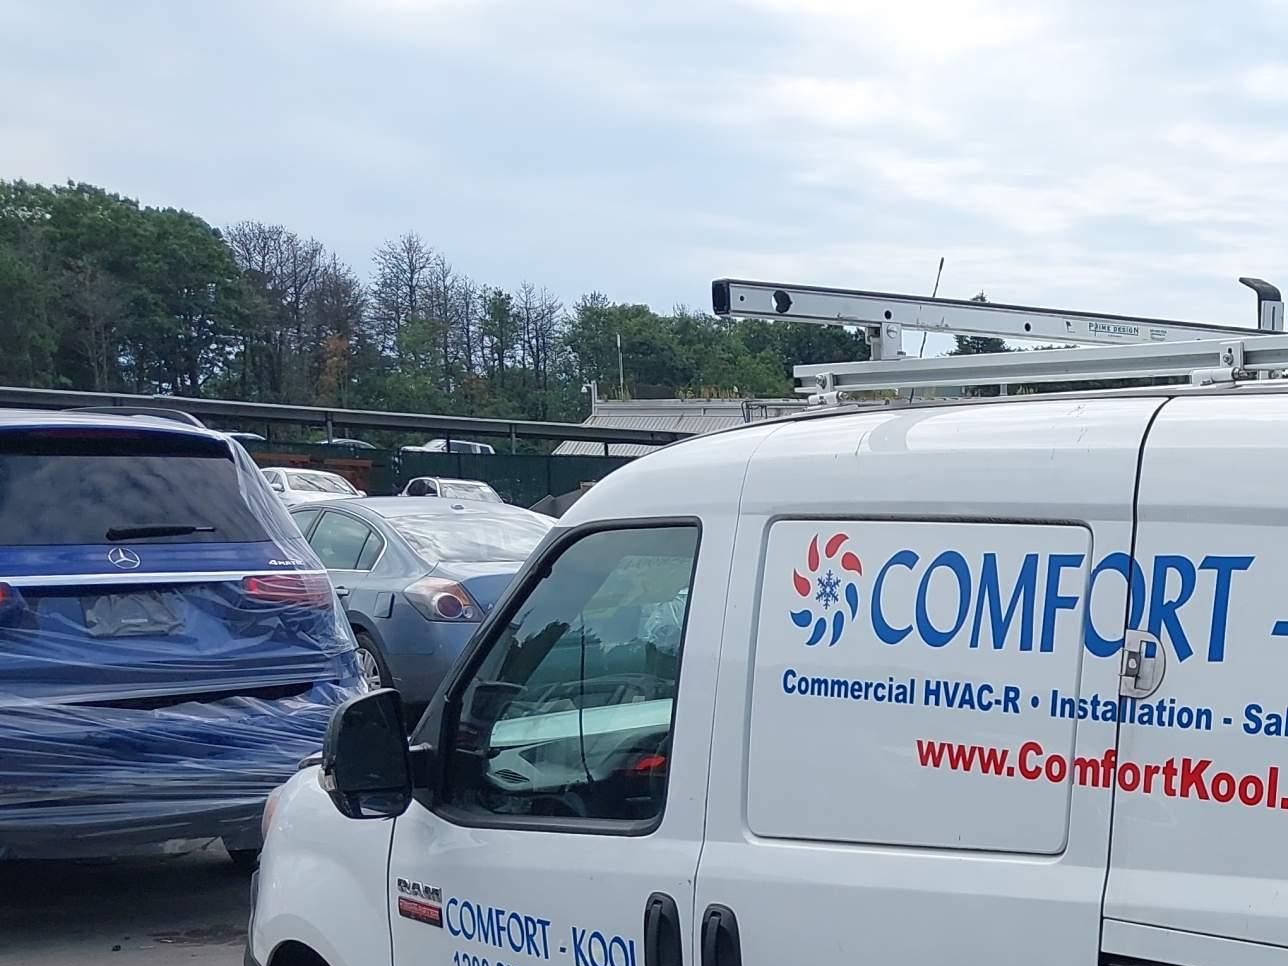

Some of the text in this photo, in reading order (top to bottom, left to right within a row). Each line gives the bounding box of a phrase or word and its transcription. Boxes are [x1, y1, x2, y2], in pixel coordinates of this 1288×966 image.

[871, 549, 1256, 663] COMFORT
[782, 668, 915, 705] Commercial
[923, 680, 1021, 714] HVAC-R
[1050, 689, 1212, 730] Installation
[446, 898, 551, 959] COMFORT
